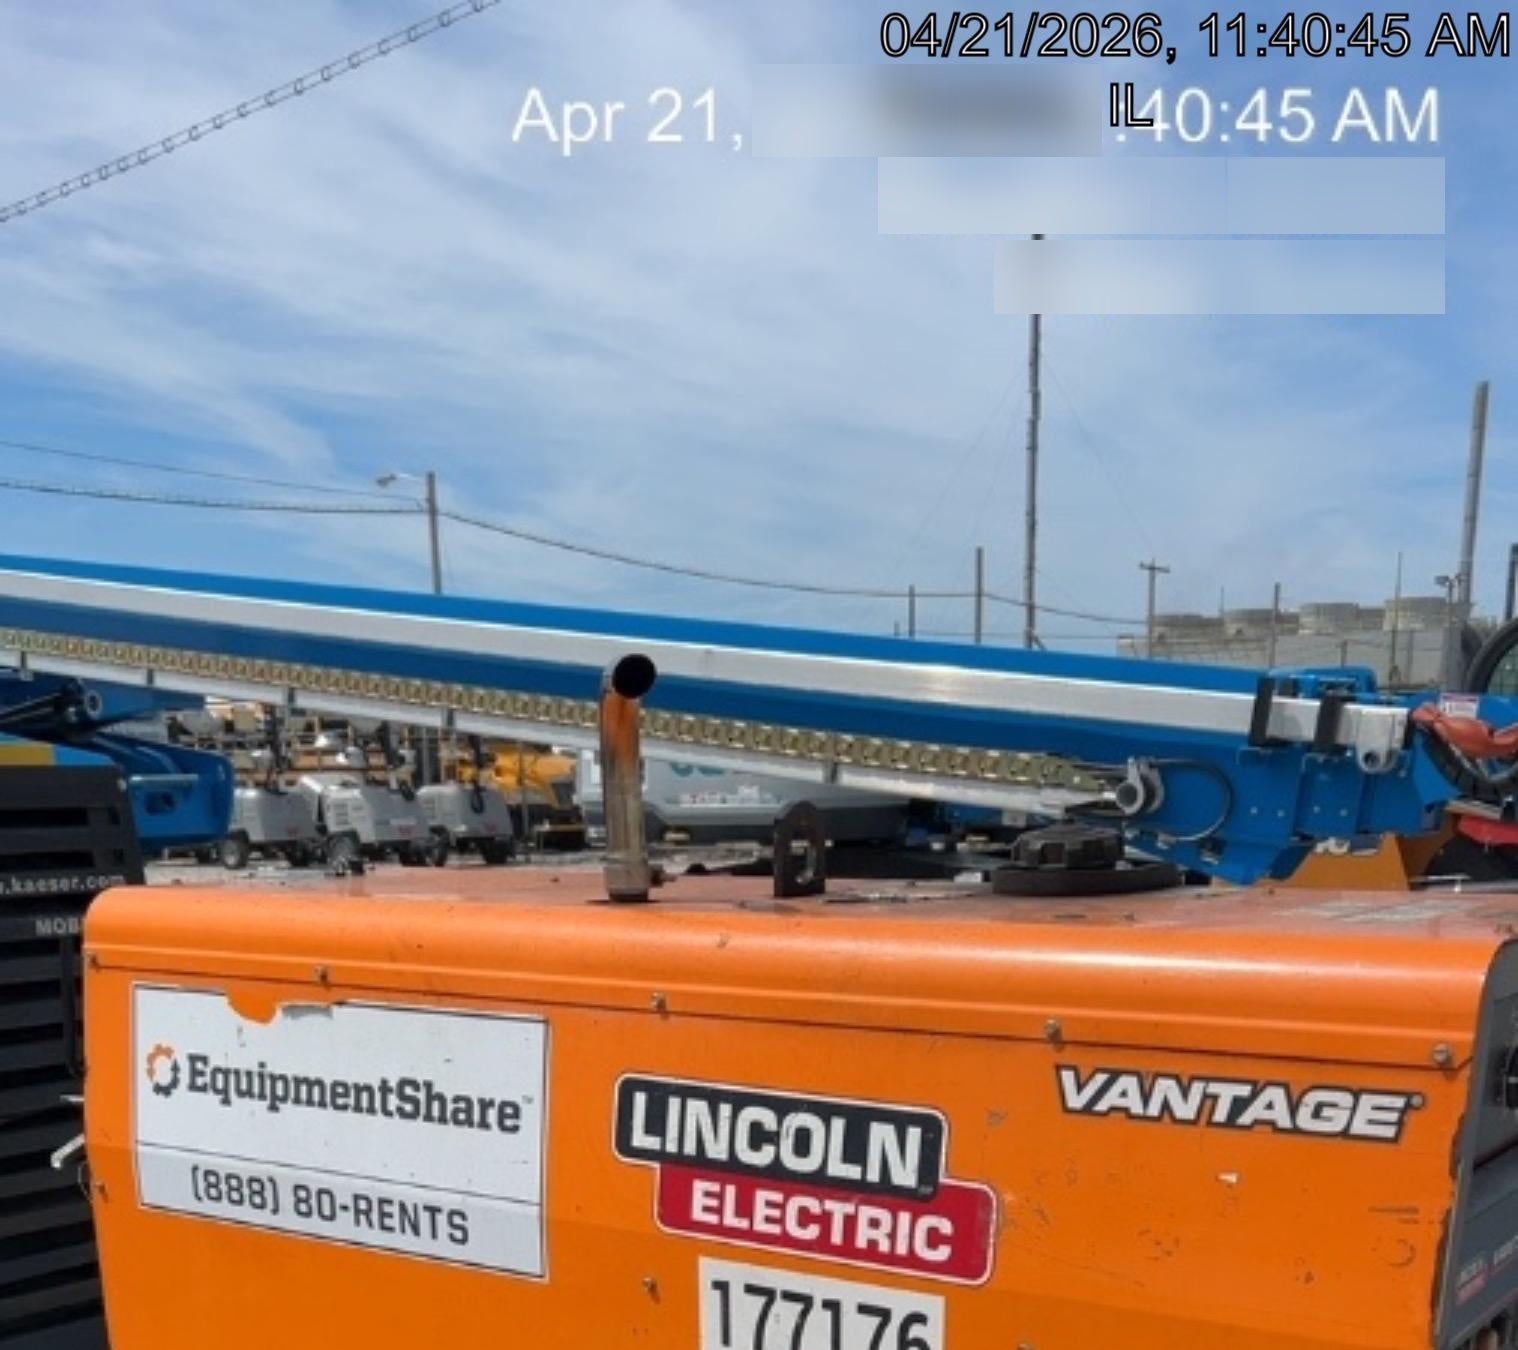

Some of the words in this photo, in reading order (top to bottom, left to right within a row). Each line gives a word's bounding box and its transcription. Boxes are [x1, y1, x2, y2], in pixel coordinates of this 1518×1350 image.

[0, 875, 126, 895] .kaeser.com
[187, 1053, 521, 1134] EquipmentShare
[1058, 1068, 1409, 1140] VANTAGE
[630, 1090, 922, 1189] LINCOLN
[191, 1164, 280, 1216] (888)
[293, 1185, 470, 1246] 80-RENTS
[690, 1178, 954, 1262] ELECTRIC
